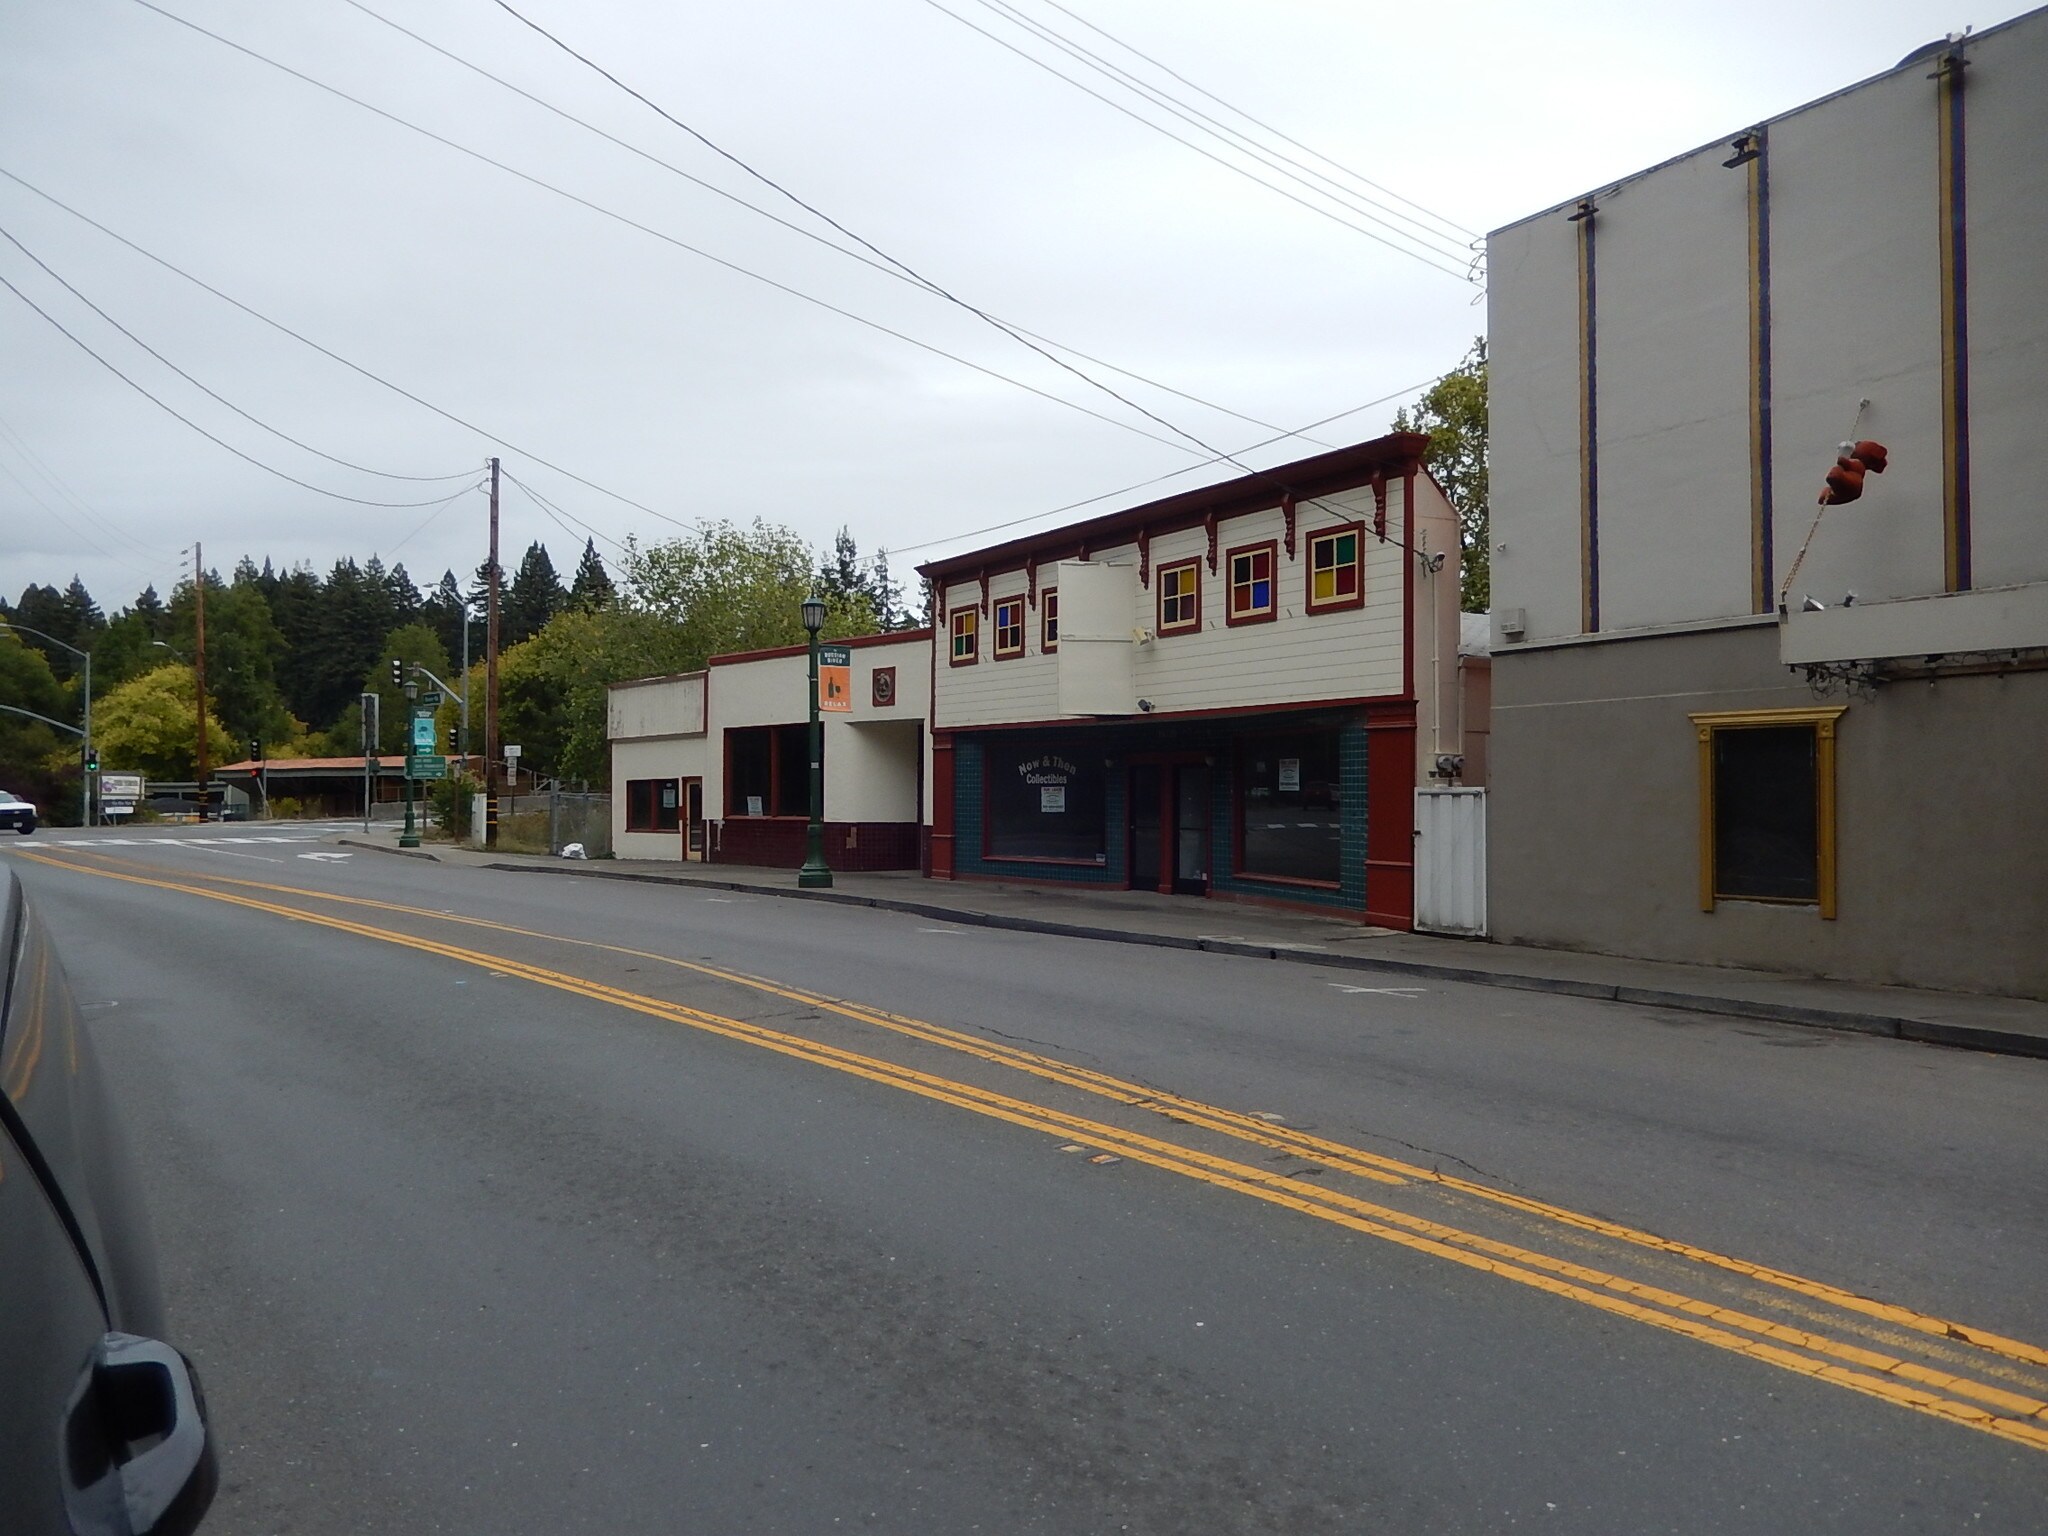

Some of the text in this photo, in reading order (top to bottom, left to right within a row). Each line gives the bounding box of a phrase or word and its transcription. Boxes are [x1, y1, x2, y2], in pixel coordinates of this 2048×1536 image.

[1018, 755, 1077, 776] Now & Then
[1026, 773, 1067, 784] Collectibles
